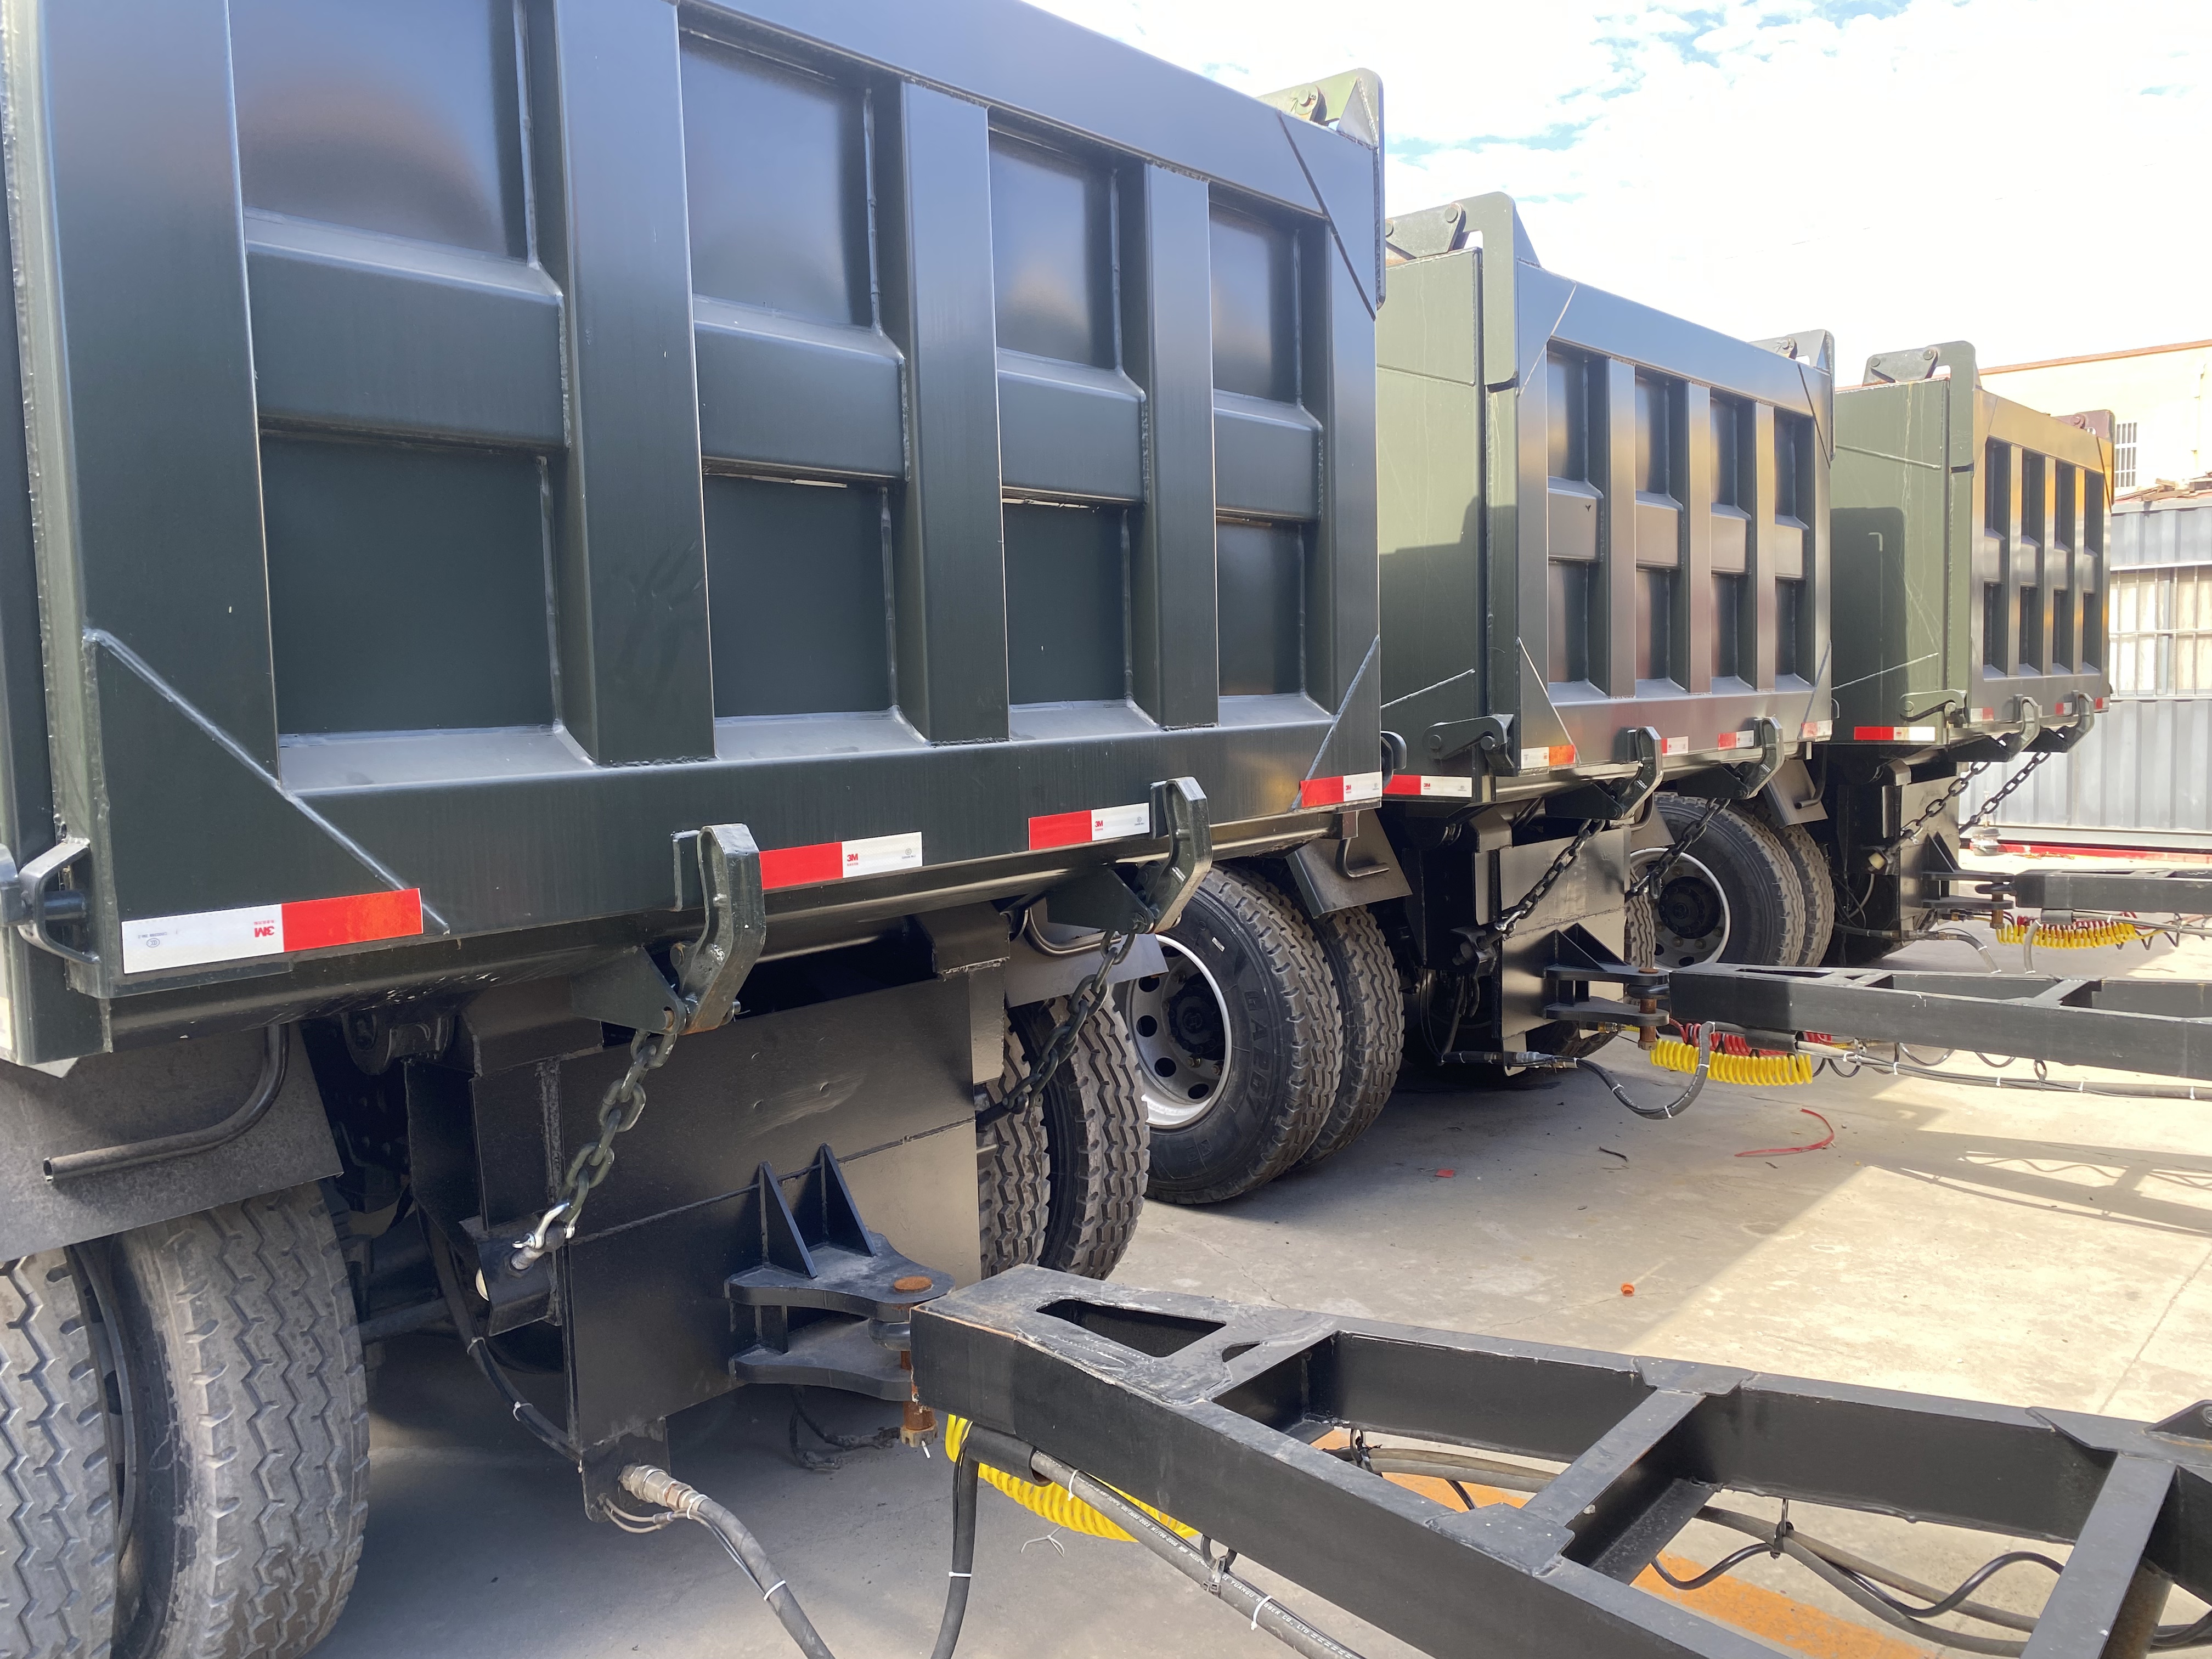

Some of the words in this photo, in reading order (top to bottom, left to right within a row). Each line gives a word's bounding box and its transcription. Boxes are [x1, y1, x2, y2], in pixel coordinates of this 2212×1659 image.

[847, 853, 859, 862] 3M
[254, 926, 275, 938] 3M
[1231, 1580, 1255, 1598] YUANGU
[1255, 1598, 1281, 1615] RBBER
[1296, 1624, 1310, 1634] LTD
